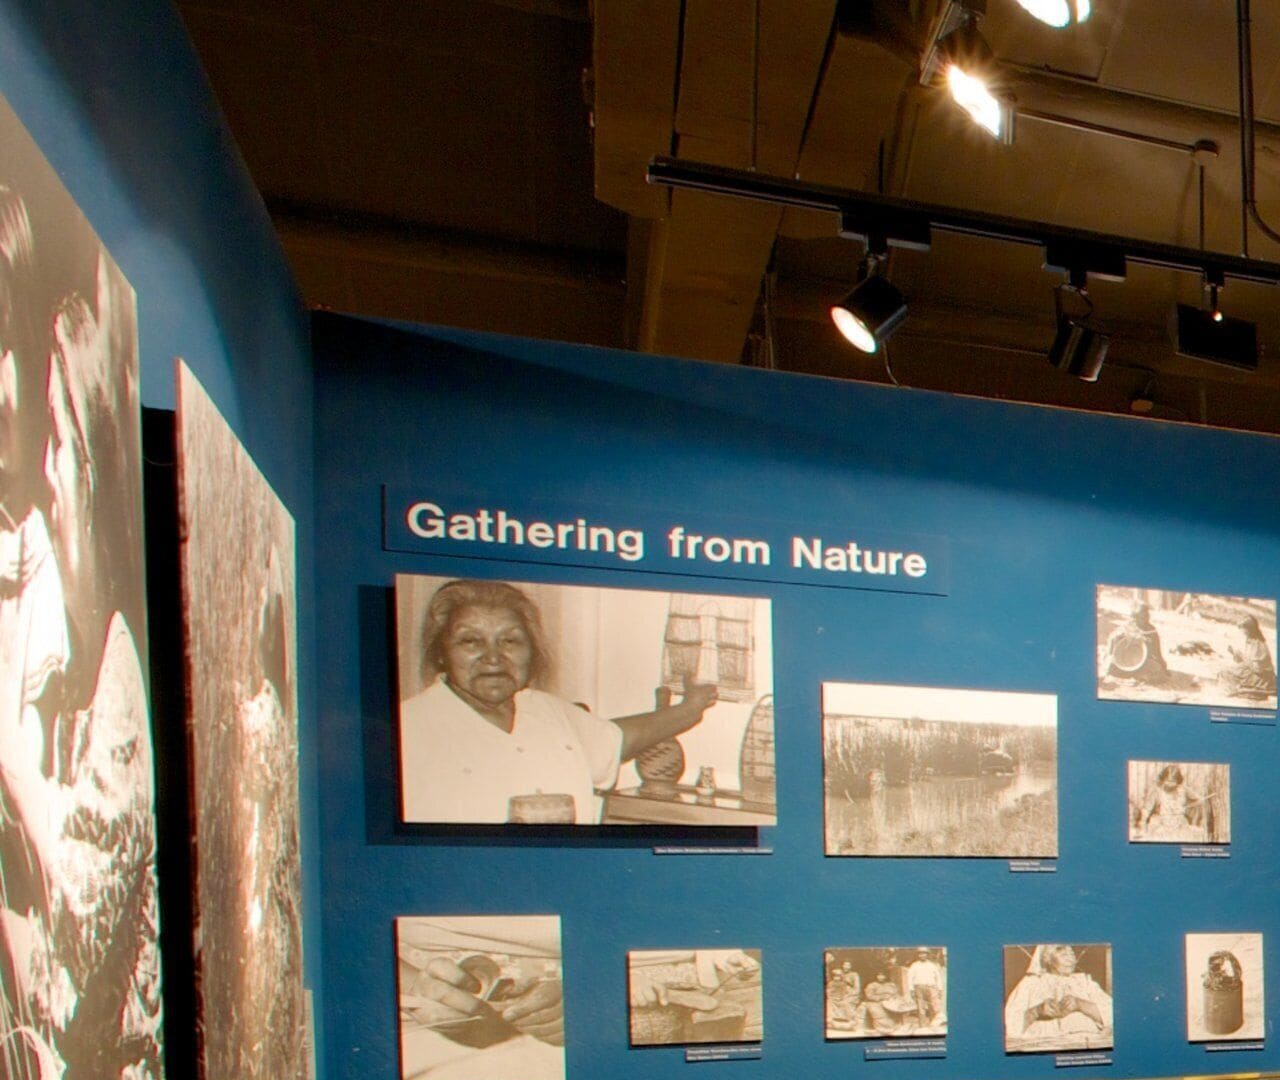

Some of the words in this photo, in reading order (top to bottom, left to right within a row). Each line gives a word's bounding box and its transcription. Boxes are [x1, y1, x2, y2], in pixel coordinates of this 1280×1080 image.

[406, 502, 644, 561] Gathering
[668, 526, 771, 566] from
[792, 536, 927, 578] Nature
